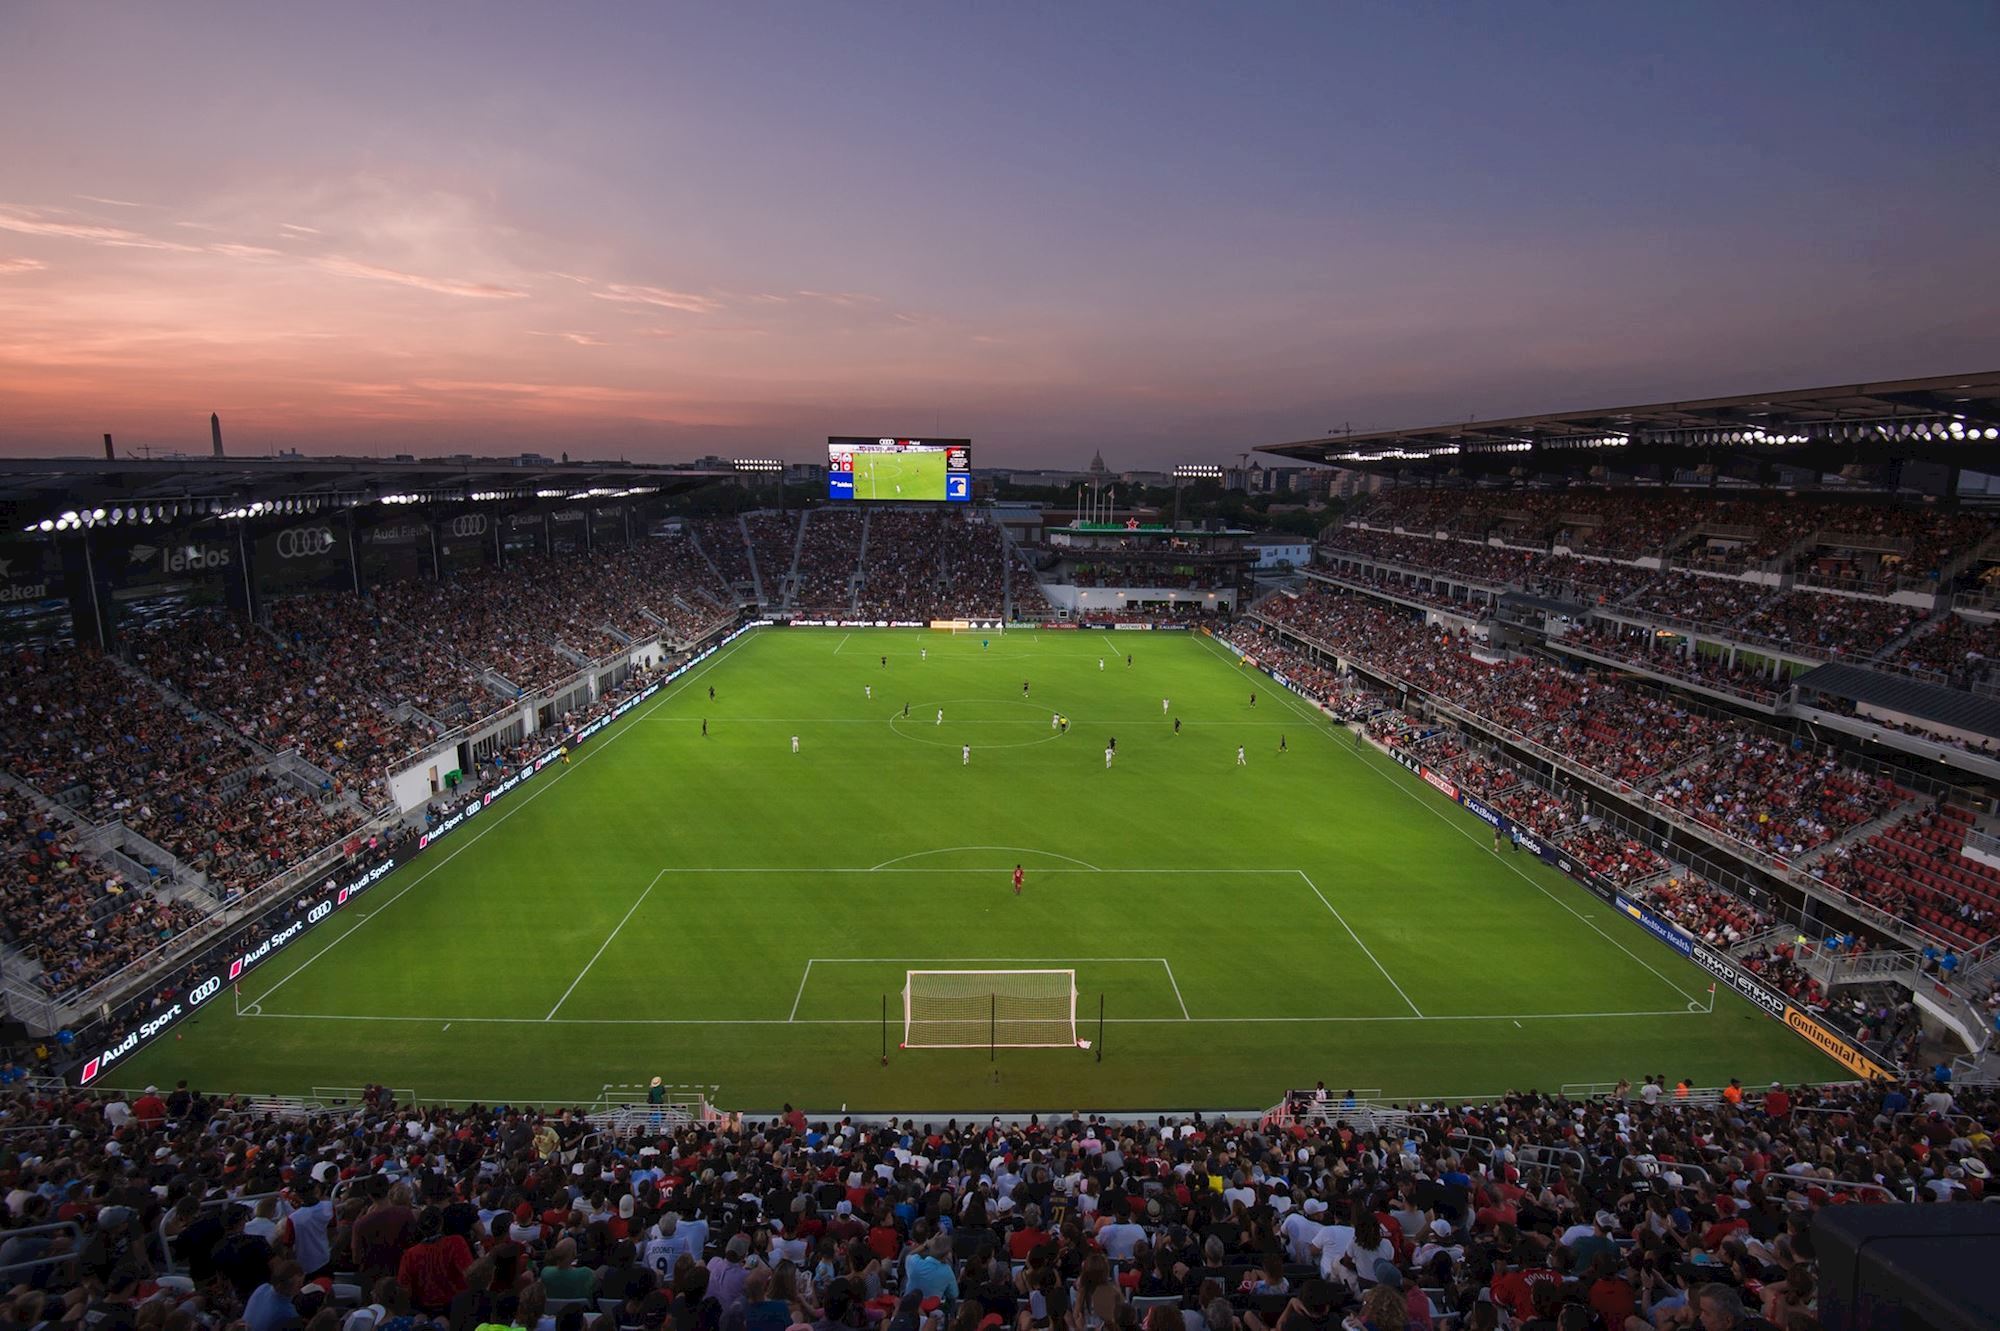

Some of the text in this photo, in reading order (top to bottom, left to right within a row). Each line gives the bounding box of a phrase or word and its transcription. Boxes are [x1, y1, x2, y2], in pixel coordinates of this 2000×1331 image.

[490, 775, 519, 799] Audi Sport
[428, 813, 464, 841] Audi Sport
[1466, 799, 1499, 826] EAGLEBANK
[349, 859, 394, 895] Audi Sport
[244, 921, 303, 967] Audi Sport
[1641, 914, 1690, 953] MedStar Health
[1693, 947, 1735, 979] ETIHAD
[1738, 977, 1784, 1011] ETIHAD
[101, 1004, 182, 1067] Audi Sport
[1789, 1011, 1856, 1065] Continental
